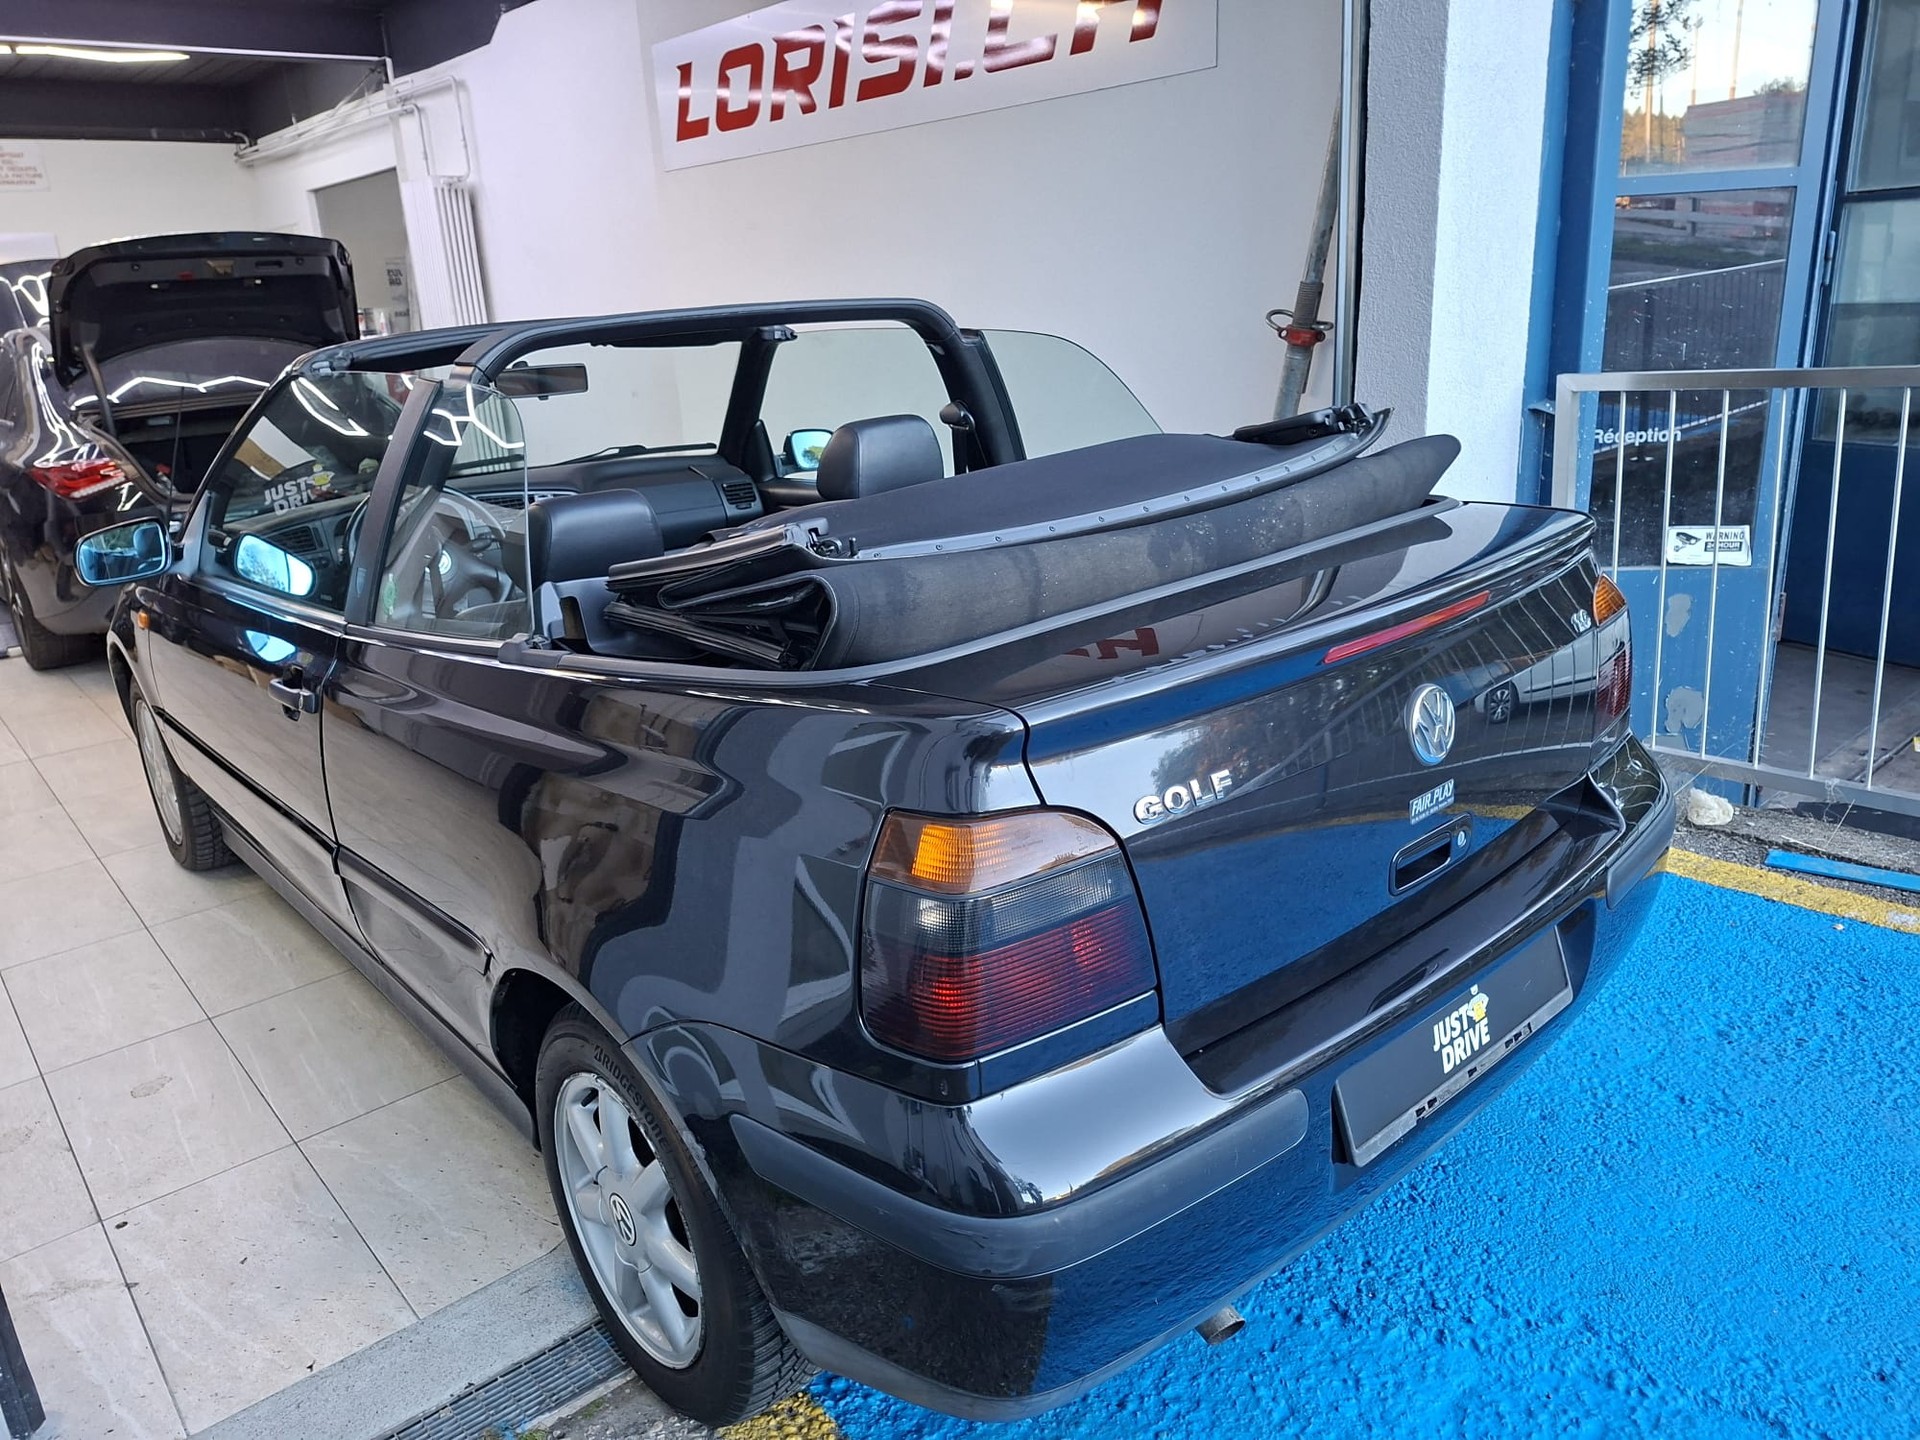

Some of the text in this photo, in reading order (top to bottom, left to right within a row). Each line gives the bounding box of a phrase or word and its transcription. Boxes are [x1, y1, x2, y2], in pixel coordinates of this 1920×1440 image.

[264, 476, 310, 505] JUST
[1133, 769, 1232, 825] GOLF
[1433, 1003, 1470, 1052] JUST
[1442, 1017, 1490, 1074] DRIVE
[593, 1043, 669, 1152] BRIDGESTONE
